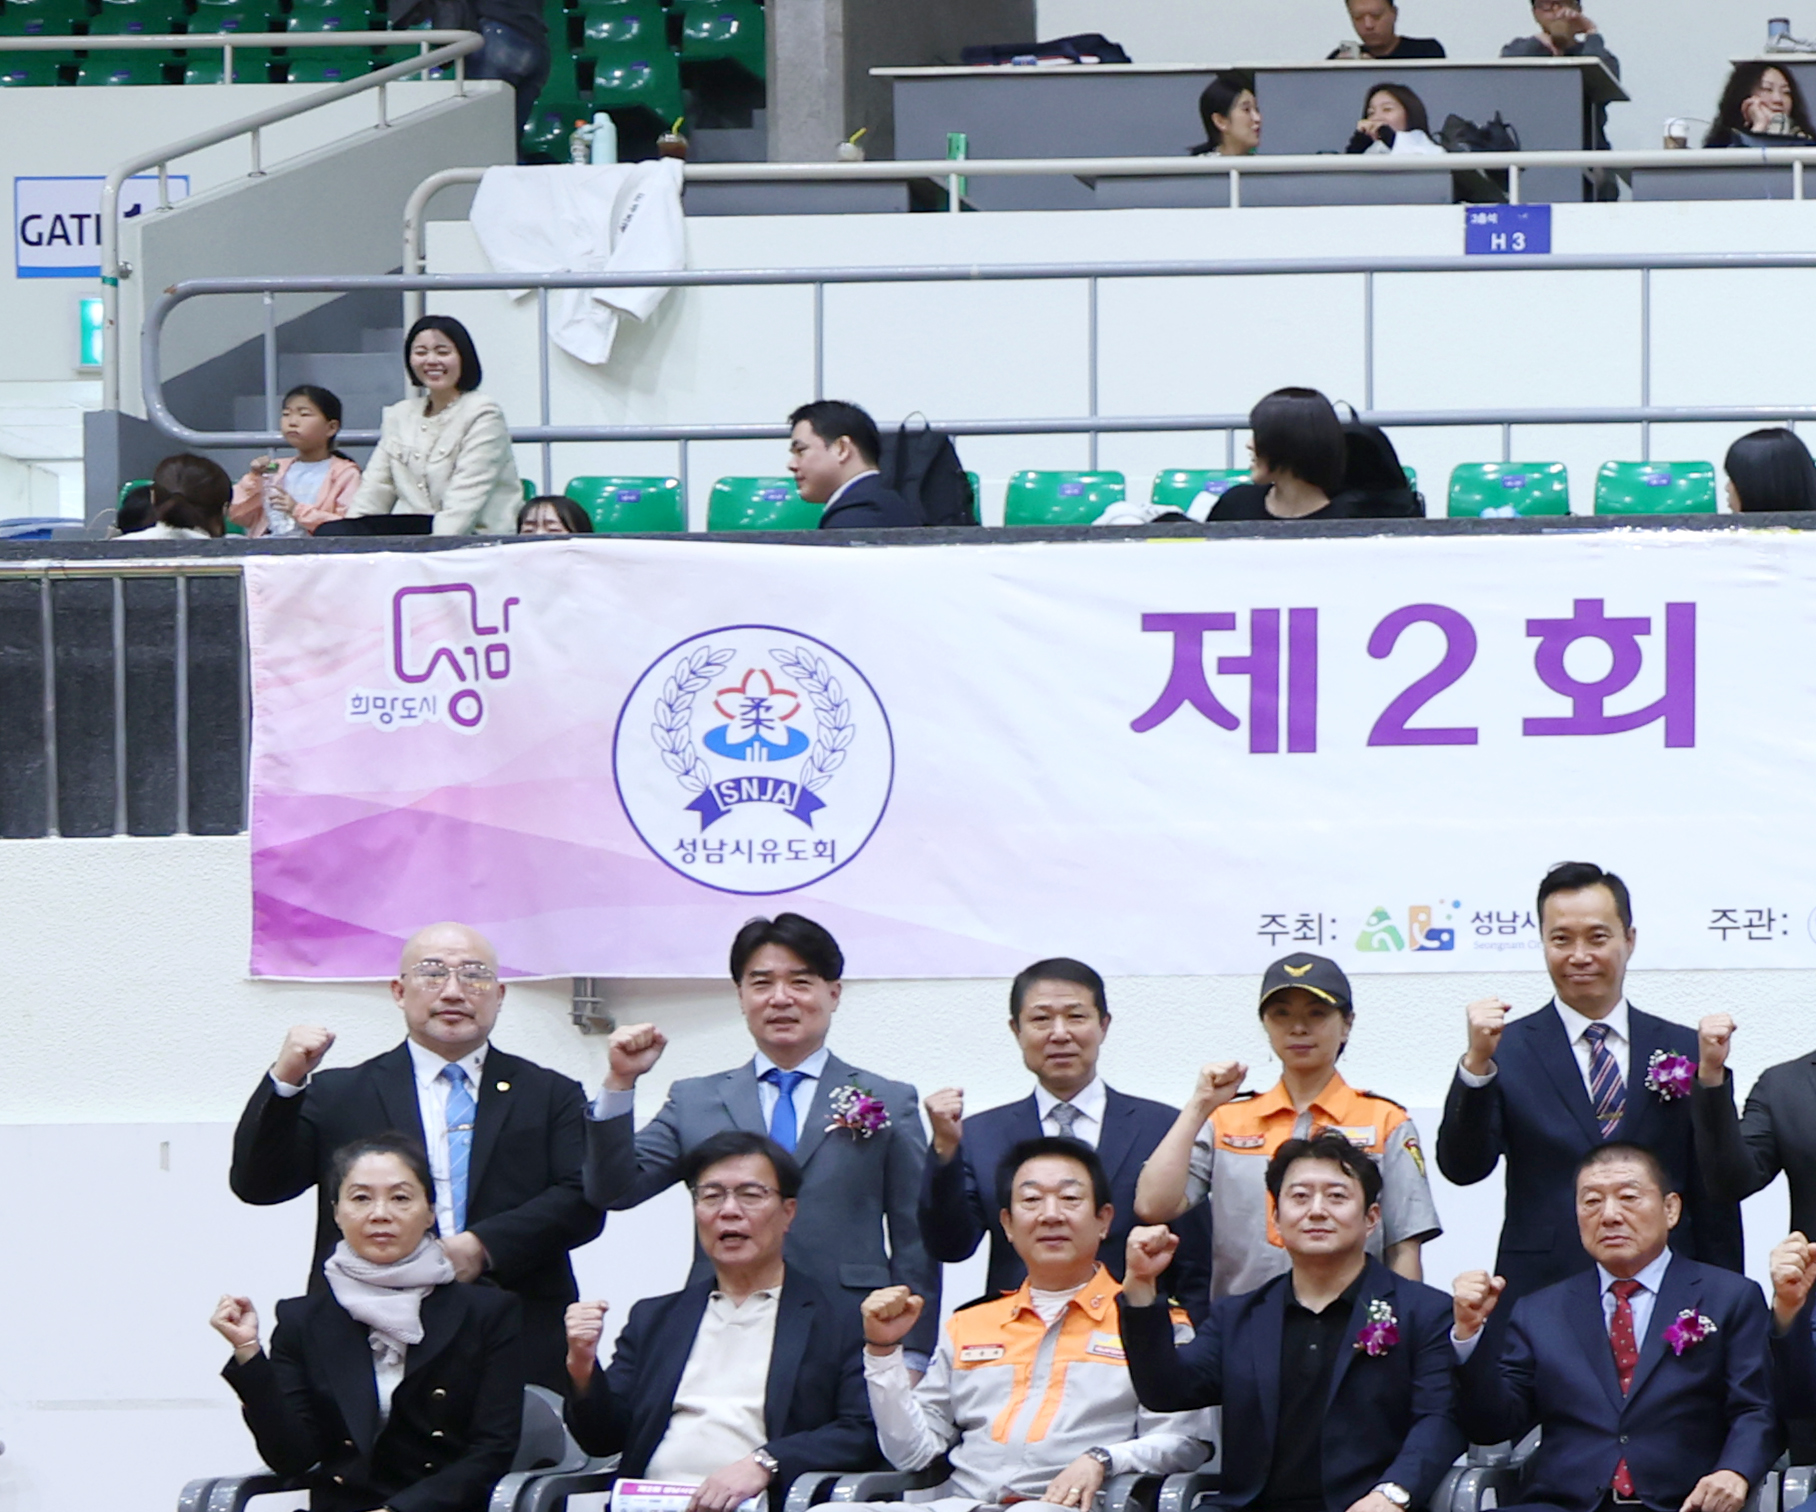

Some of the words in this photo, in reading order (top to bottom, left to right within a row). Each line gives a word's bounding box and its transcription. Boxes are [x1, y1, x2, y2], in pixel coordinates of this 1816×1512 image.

[20, 213, 102, 246] GAT
[1130, 597, 1697, 755] 제2회
[349, 693, 437, 724] 희망도시
[719, 777, 793, 806] SNJA
[673, 837, 836, 865] 성남시유도회
[1257, 911, 1337, 947] 주최:
[1707, 906, 1789, 941] 주관:
